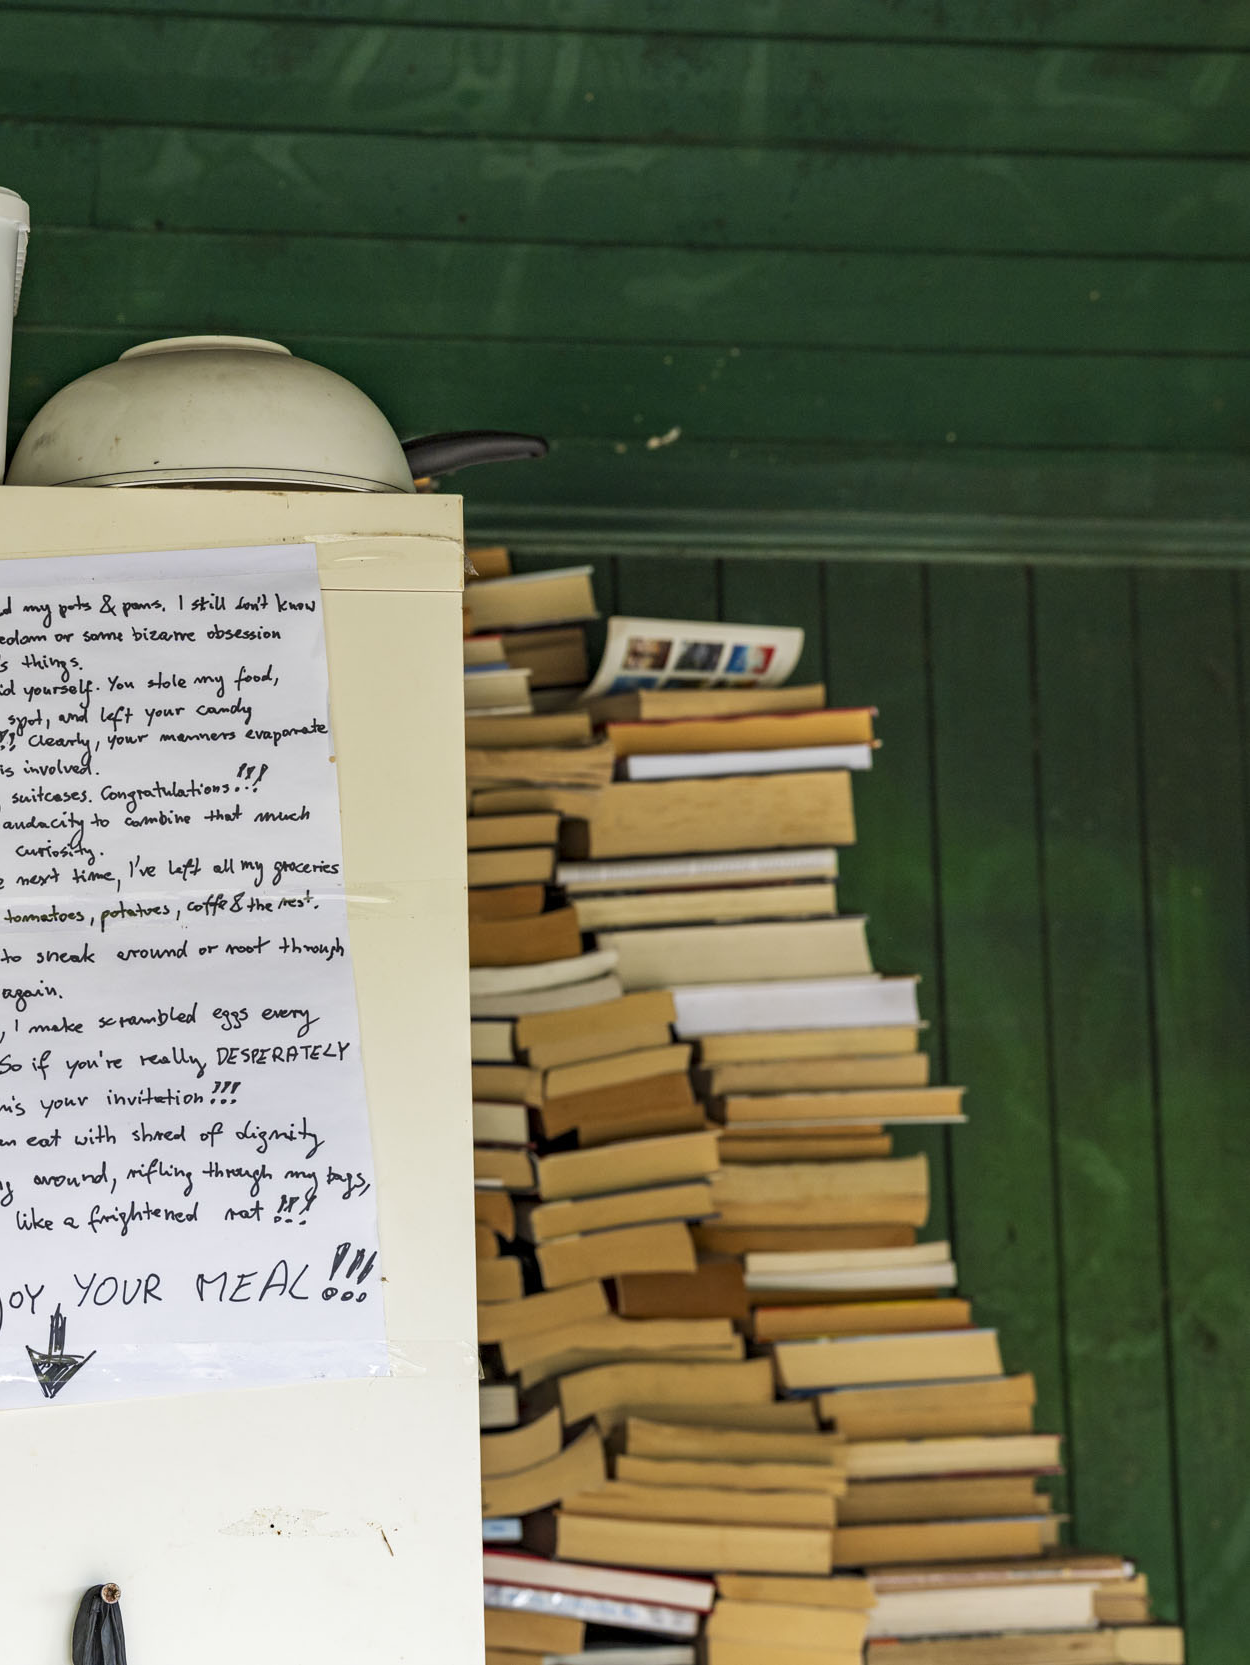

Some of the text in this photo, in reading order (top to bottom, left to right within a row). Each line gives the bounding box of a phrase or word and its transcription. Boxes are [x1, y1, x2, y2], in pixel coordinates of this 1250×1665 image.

[22, 603, 53, 629] my
[57, 594, 93, 619] pots
[121, 599, 166, 618] pans.
[190, 592, 227, 612] still
[234, 593, 269, 612] don't
[274, 592, 316, 613] know
[81, 630, 124, 643] some
[131, 625, 197, 643] bizarre
[206, 623, 282, 641] obsession
[20, 653, 84, 684] things.
[22, 678, 101, 710] yourself.
[107, 675, 135, 693] You
[147, 671, 188, 690] stole
[233, 663, 279, 692] food,
[7, 709, 51, 737] spot,
[58, 708, 89, 724] and
[100, 705, 134, 733] left
[144, 706, 186, 728] your
[195, 696, 253, 726] candy
[28, 731, 101, 768] Clearly,
[107, 733, 149, 751] your
[159, 731, 237, 744] manners
[244, 717, 329, 748] evaporate
[22, 757, 100, 777] involved.
[11, 785, 93, 805] suitcases.
[100, 762, 269, 813] Congratulations!!!
[2, 811, 85, 848] audacity
[123, 809, 192, 828] combine
[203, 803, 244, 822] that
[253, 804, 311, 823] much
[14, 839, 105, 867] curiosity.
[15, 867, 61, 887] next
[71, 867, 121, 893] time,
[128, 854, 157, 879] I've
[168, 856, 202, 882] left
[273, 857, 341, 886] groceries
[3, 904, 95, 927] tomatoes,
[100, 900, 181, 934] potatoes,
[36, 942, 96, 965] sneak
[116, 939, 189, 962] around
[224, 935, 271, 956] root
[278, 936, 345, 962] through
[1, 979, 64, 1013] again.
[27, 1016, 84, 1034] make
[98, 1001, 199, 1029] scrambled
[211, 1007, 249, 1032] eggs
[260, 1007, 321, 1039] every
[65, 1049, 123, 1080] you're
[139, 1046, 208, 1080] really
[215, 1040, 351, 1067] DESPERATELY
[39, 1095, 89, 1119] your
[106, 1080, 242, 1107] invitation!!!
[25, 1128, 62, 1149] eat
[74, 1124, 117, 1147] with
[131, 1121, 187, 1143] shred
[235, 1116, 326, 1160] dignity
[33, 1160, 117, 1195] around,
[126, 1157, 194, 1198] rifling
[201, 1160, 273, 1198] through
[326, 1165, 371, 1201] bags,
[15, 1206, 54, 1232] like
[87, 1200, 199, 1237] frightened
[73, 1272, 163, 1308] YOUR
[195, 1241, 378, 1304] MEAL!!!
